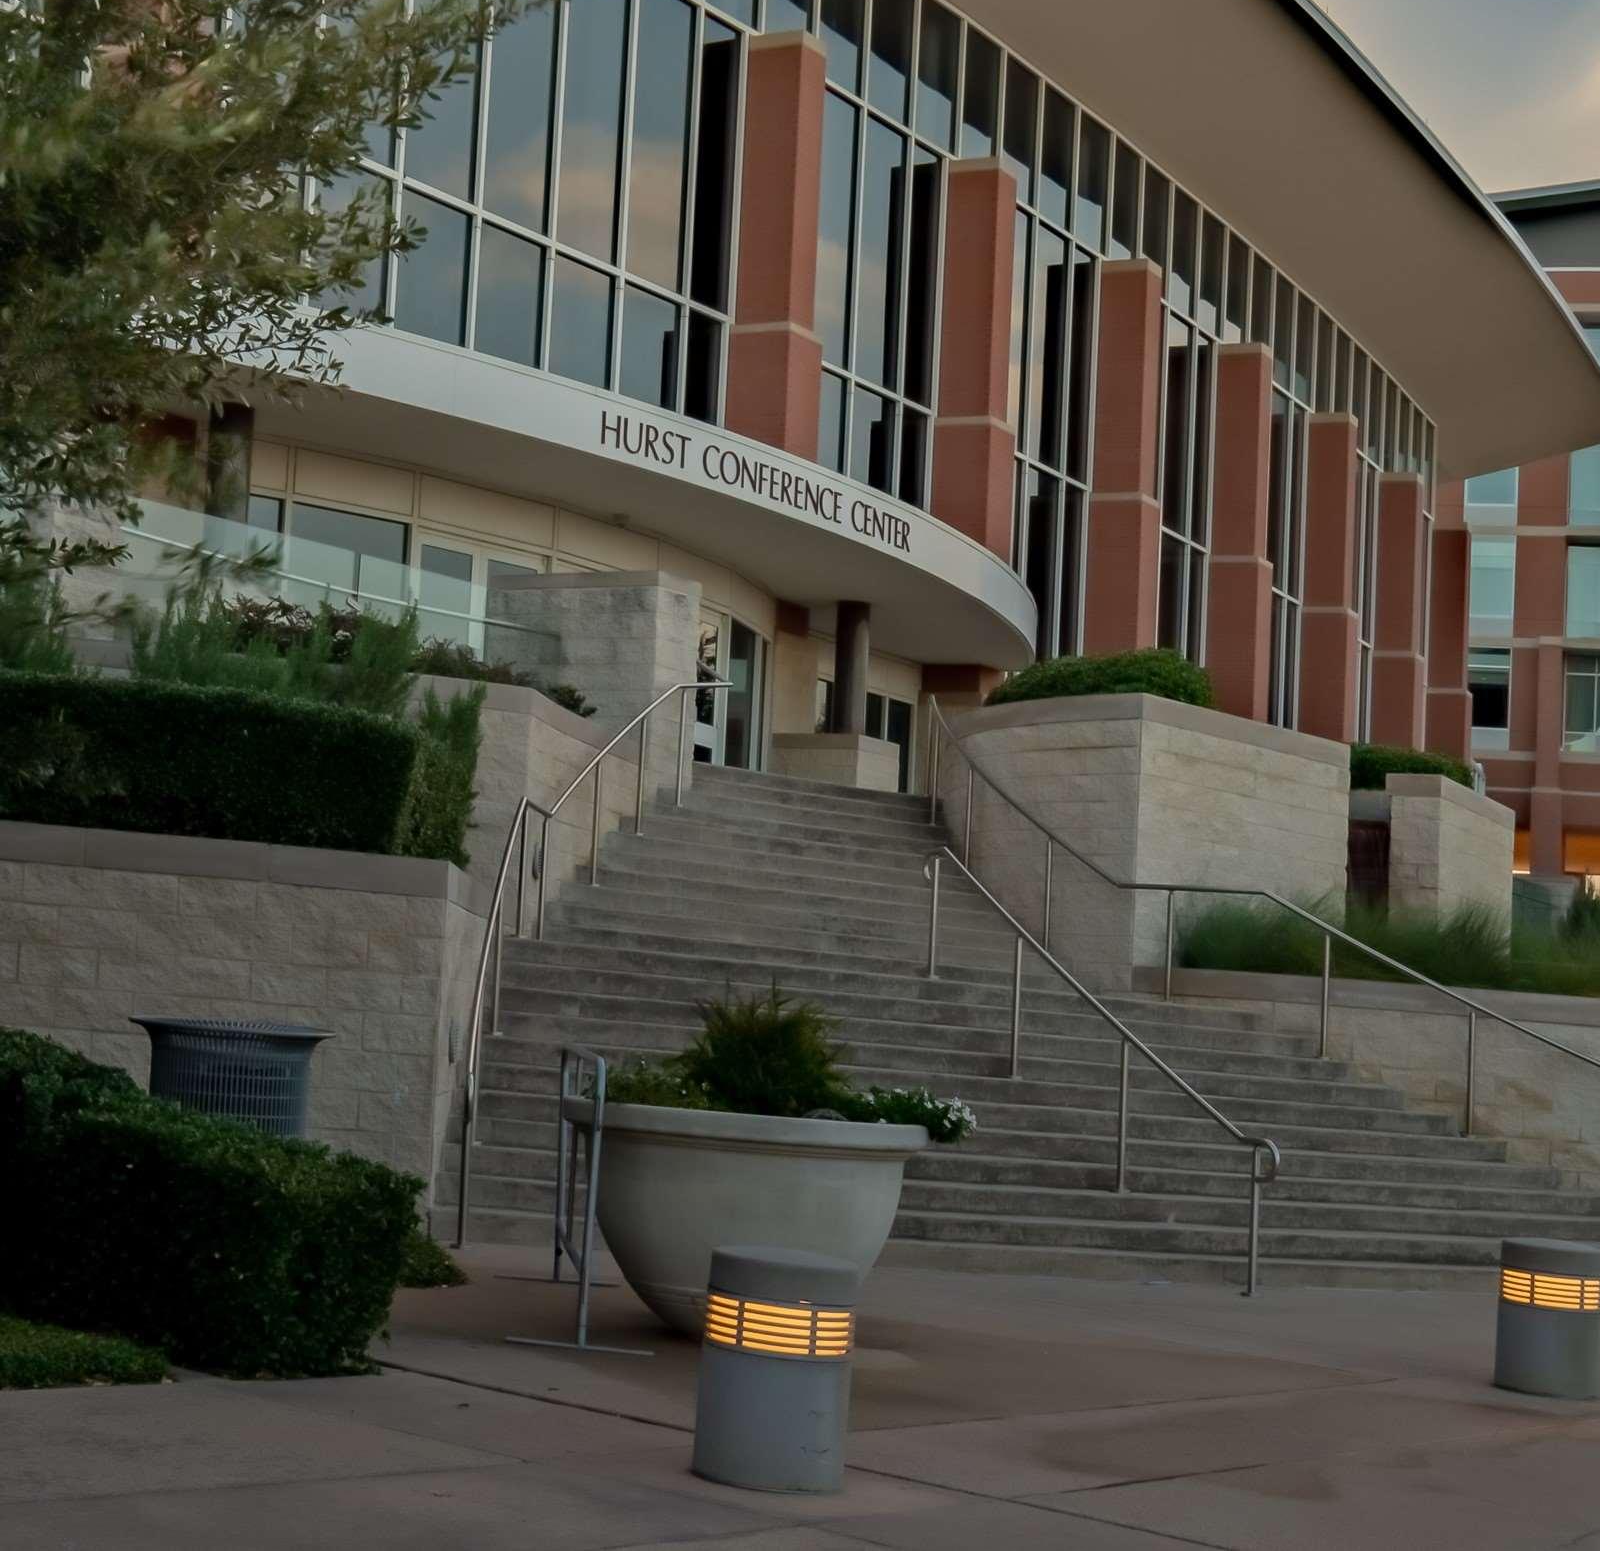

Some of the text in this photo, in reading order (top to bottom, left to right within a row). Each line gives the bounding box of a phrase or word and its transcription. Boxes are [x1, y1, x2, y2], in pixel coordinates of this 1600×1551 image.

[600, 410, 911, 553] HURST CONFERENCE CENTER
